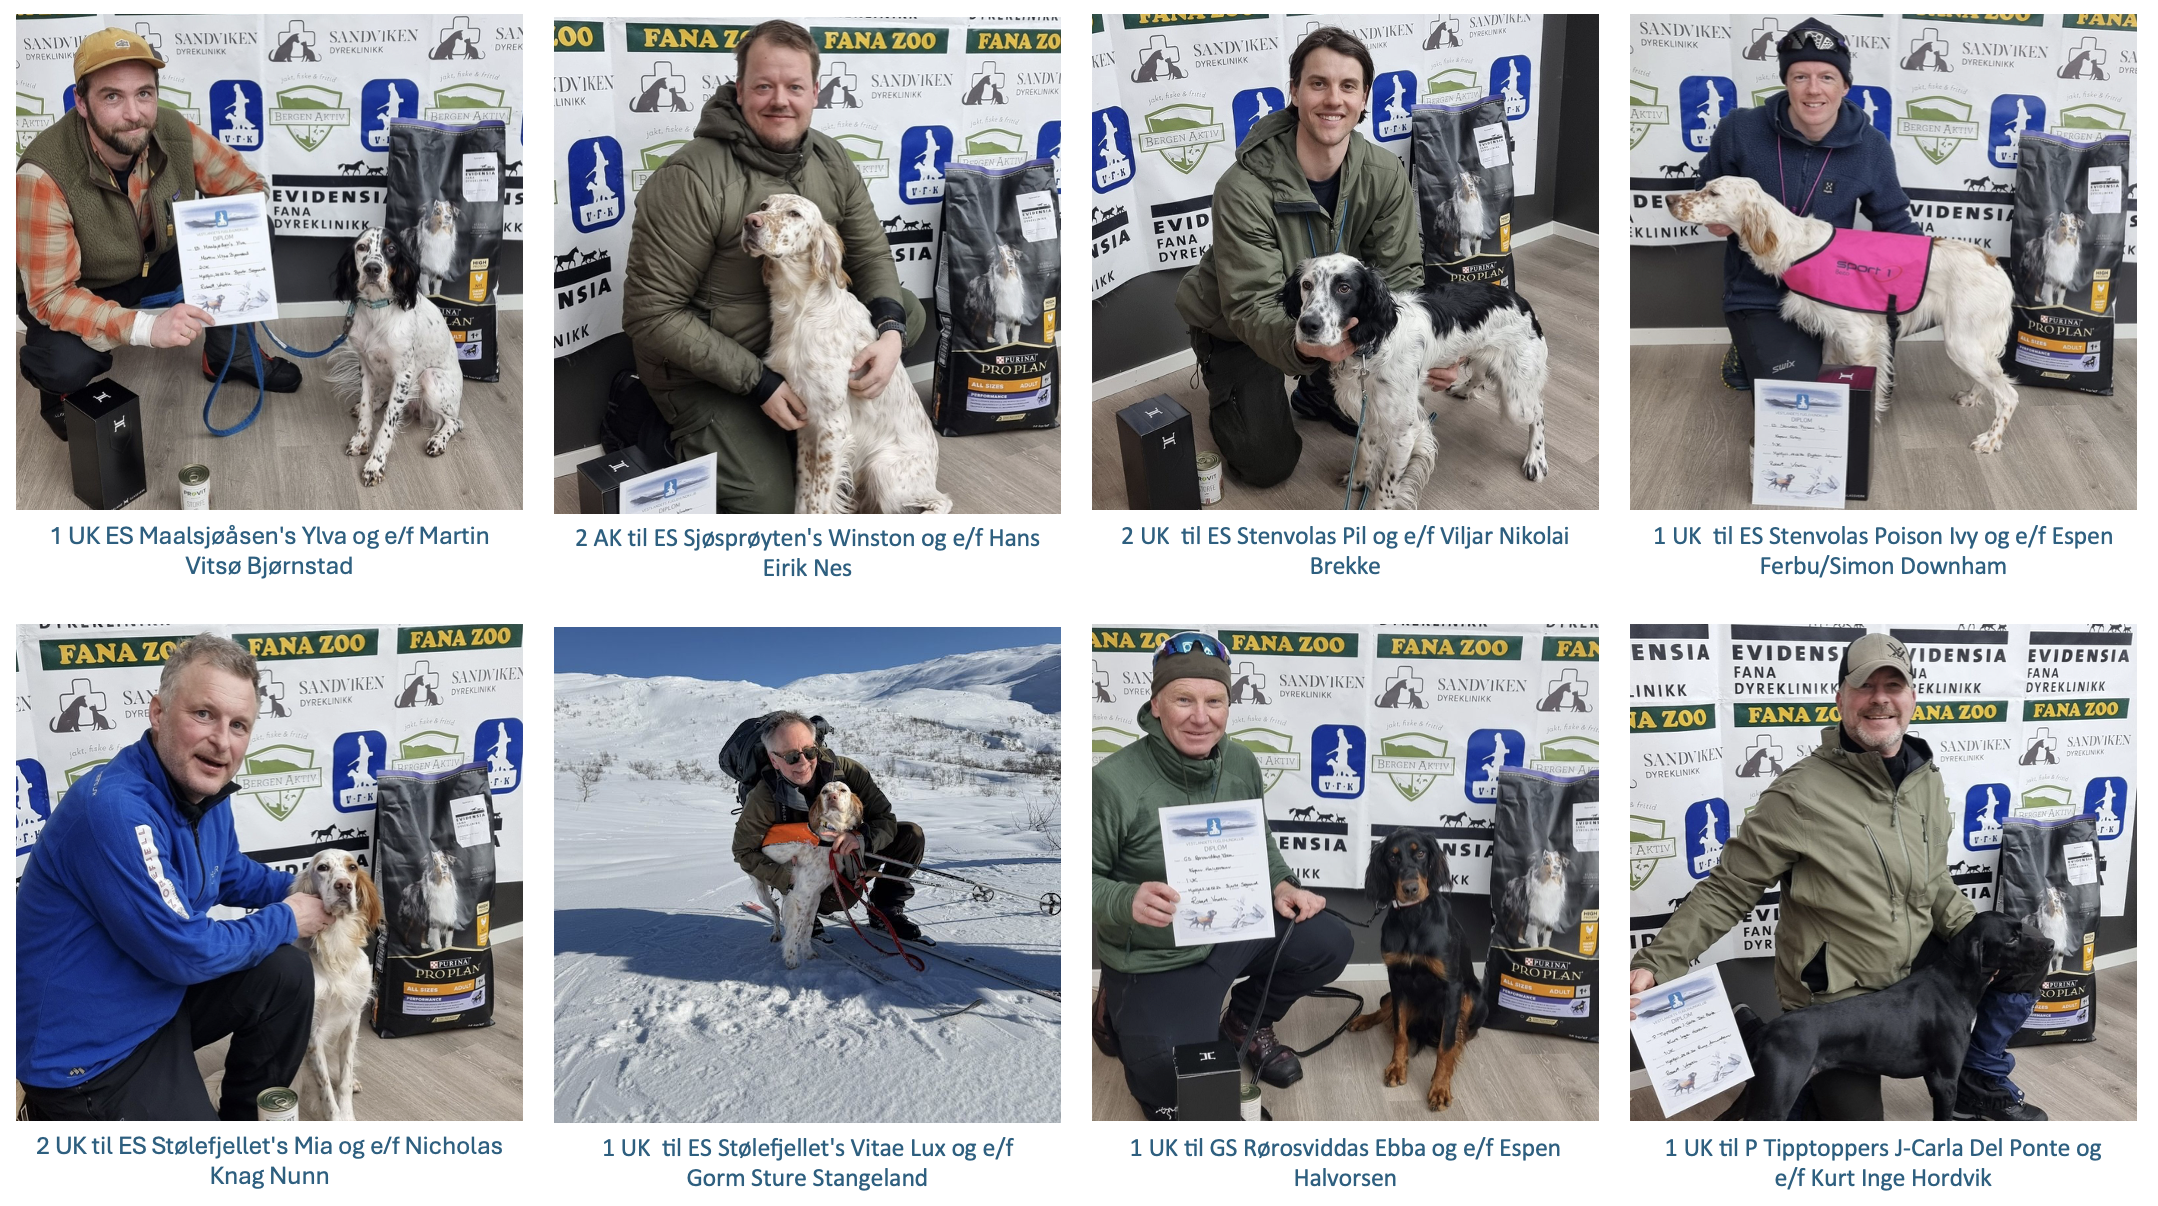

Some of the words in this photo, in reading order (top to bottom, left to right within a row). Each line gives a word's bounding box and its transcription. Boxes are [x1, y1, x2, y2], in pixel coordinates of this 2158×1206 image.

[175, 32, 257, 46] SANDVIKEN
[824, 31, 887, 50] FANA
[892, 32, 937, 50] ZOO
[176, 48, 227, 56] DYREKLINIKK
[1193, 37, 1278, 57] SANDVIKEN
[1962, 41, 2049, 59] SANDVIKEN
[1195, 57, 1249, 68] DYREKLINIKK
[1961, 58, 2015, 68] DYREKLINIKK
[273, 206, 311, 217] FANA
[274, 219, 370, 230] DYREKLINIKK
[1156, 234, 1198, 250] FANA
[1836, 260, 1881, 275] sport
[2027, 320, 2056, 334] PRO
[2056, 327, 2093, 337] PLAN
[1005, 354, 1035, 363] PURINA
[980, 363, 1011, 375] PRO
[1013, 360, 1047, 374] PLAN
[1019, 380, 1038, 389] ADULT
[410, 630, 467, 649] FANA
[471, 627, 511, 645] ZOO
[1391, 638, 1455, 656] FANA
[1459, 639, 1509, 657] ZOO
[2027, 649, 2130, 663] EVIDENSIA
[2026, 667, 2059, 679] FANA
[299, 675, 386, 695] SANDVIKEN
[1437, 678, 1528, 693] SANDVIKEN
[2025, 681, 2106, 693] DYREKLINIKK
[299, 695, 353, 708] DYREKLINIKK
[1437, 694, 1492, 703] DYREKLINIKK
[1643, 746, 1724, 768] SANDVIKEN
[1203, 844, 1228, 853] DIPLOM
[415, 968, 446, 980] PRO
[447, 964, 481, 978] PLAN
